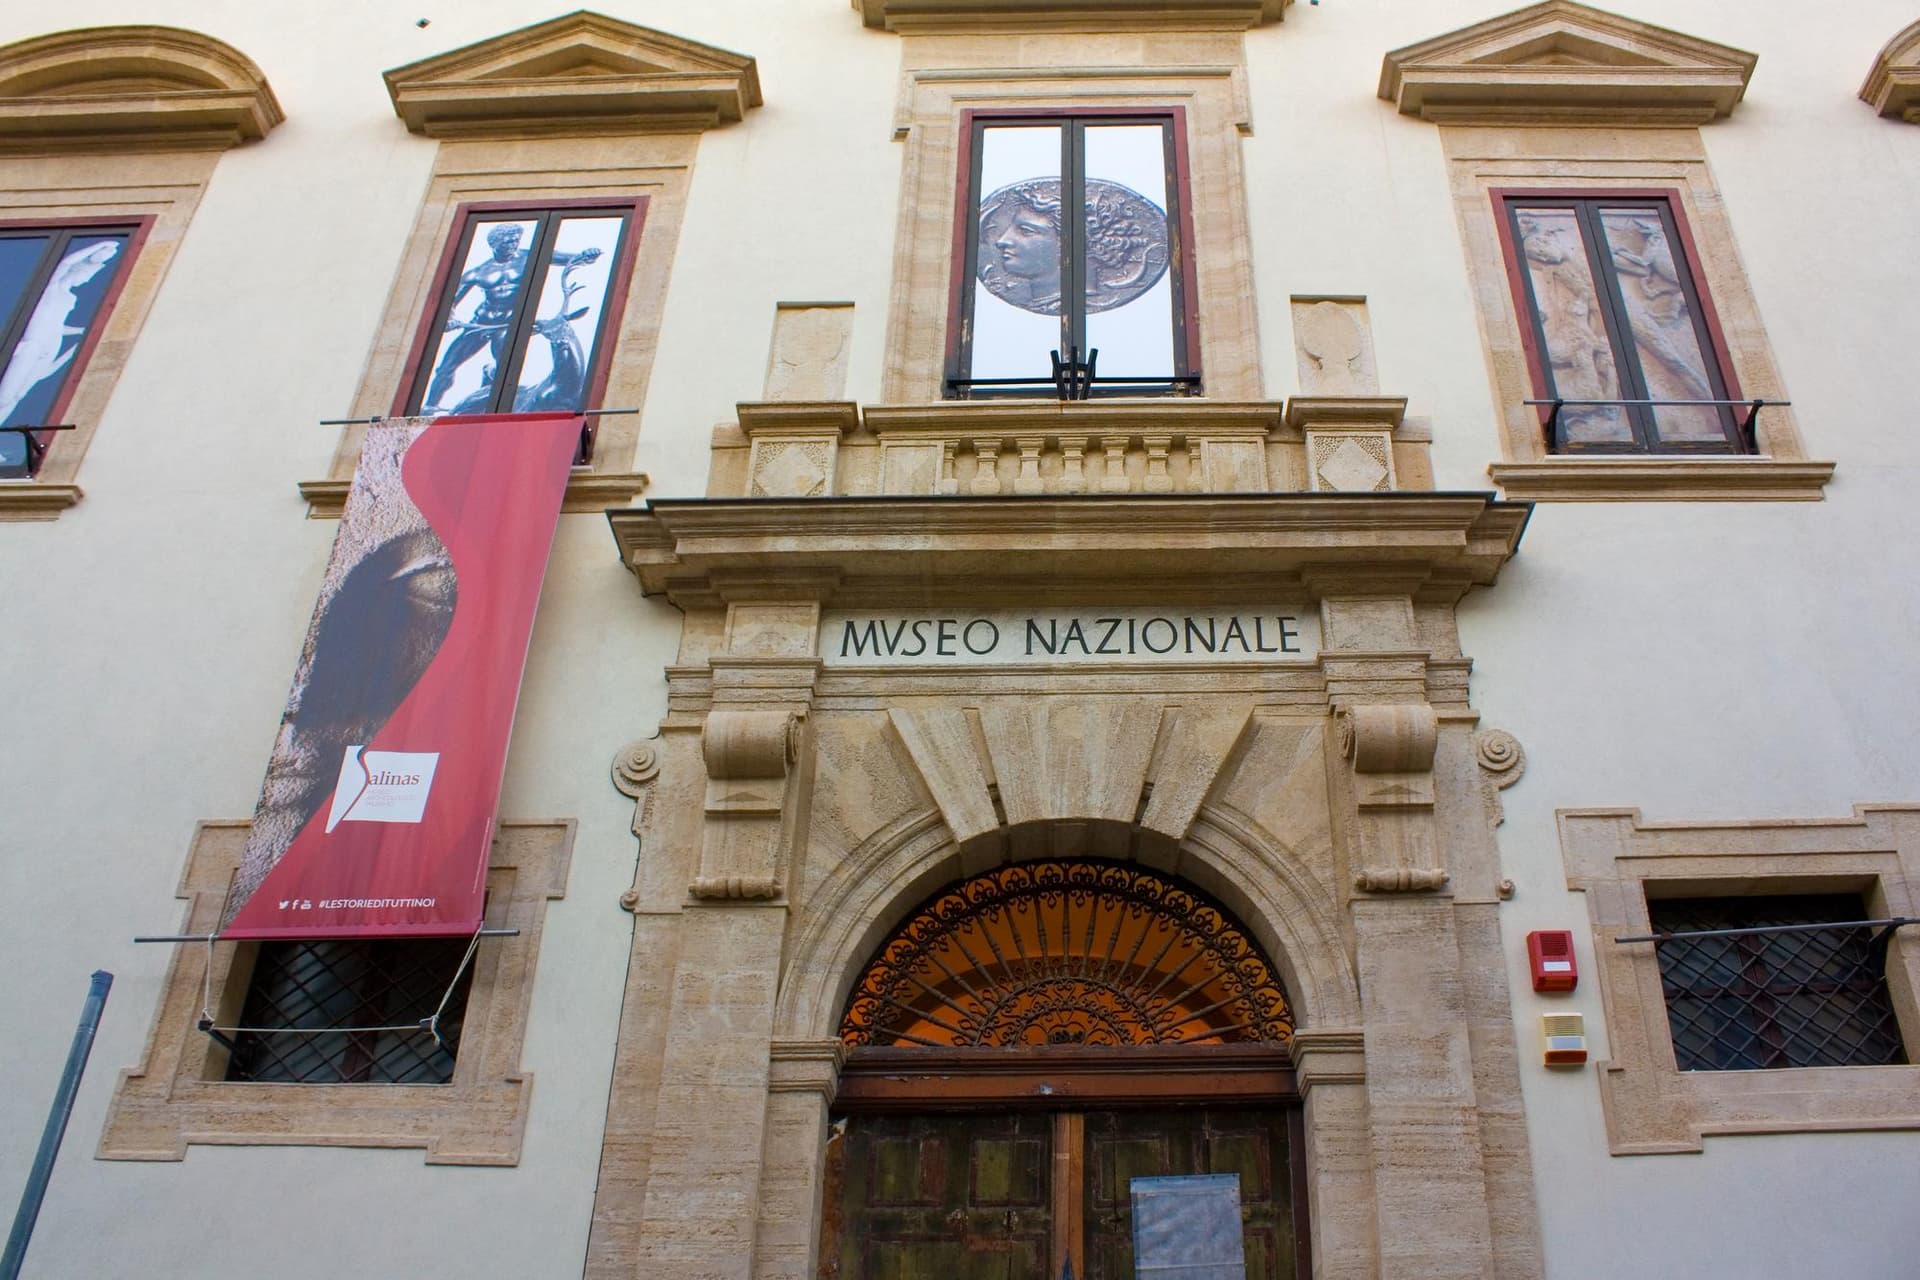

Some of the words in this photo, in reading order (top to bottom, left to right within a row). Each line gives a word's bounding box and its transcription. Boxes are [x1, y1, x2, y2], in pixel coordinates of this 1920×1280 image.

[840, 619, 999, 657] MVSEO
[1024, 616, 1301, 655] NAZIONALE
[318, 898, 435, 910] #LESTORIEDITUTTINOI
